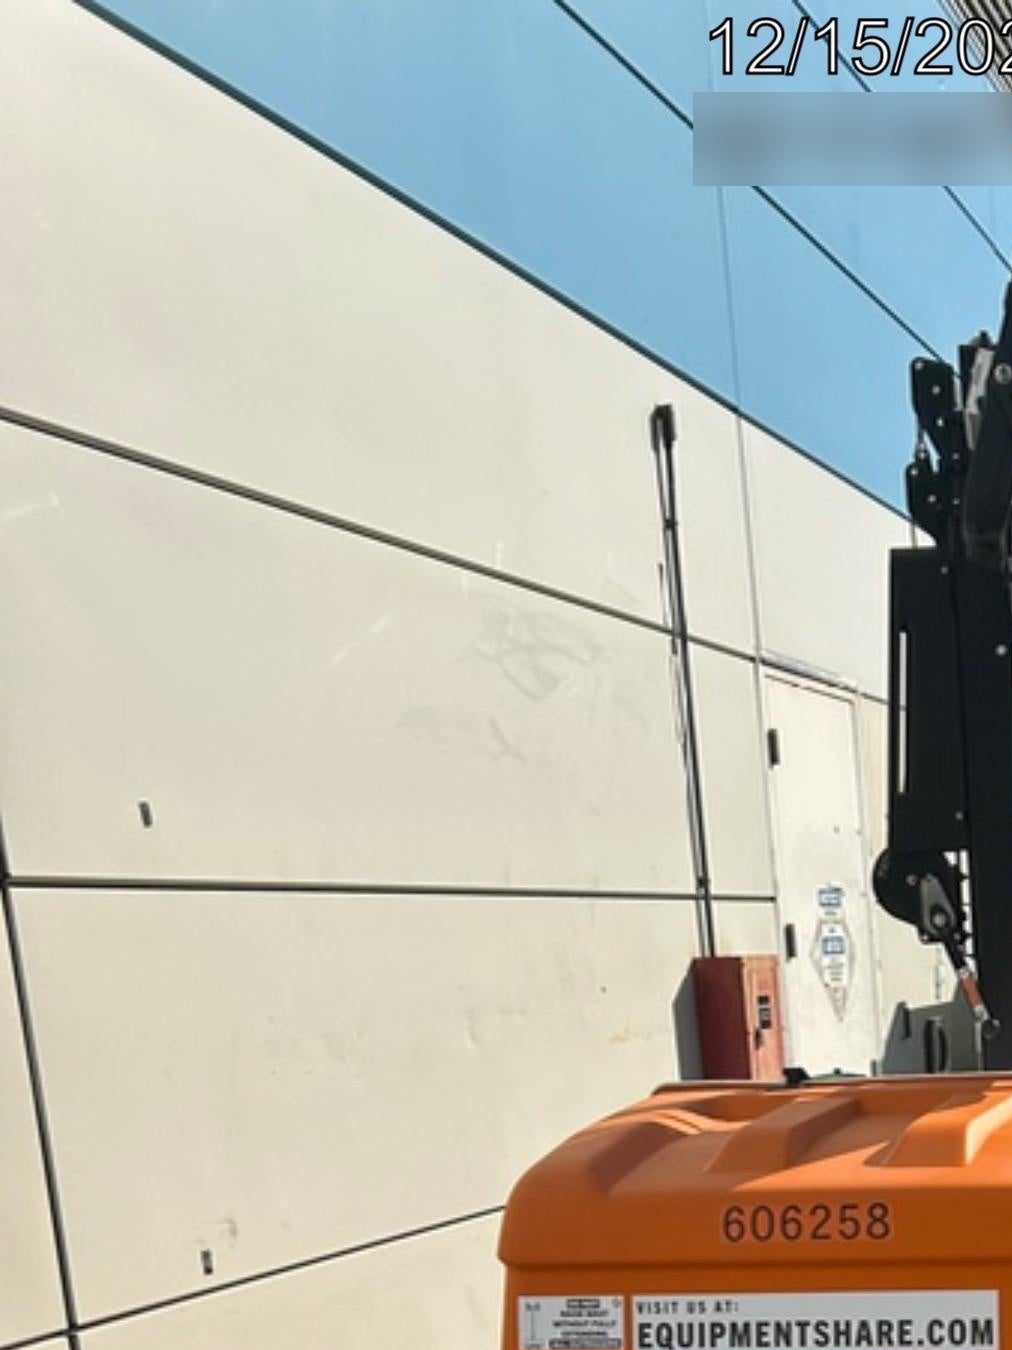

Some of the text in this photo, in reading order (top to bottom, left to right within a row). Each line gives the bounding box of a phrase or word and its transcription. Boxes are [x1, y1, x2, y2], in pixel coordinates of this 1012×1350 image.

[722, 1203, 892, 1243] 606258
[635, 1299, 740, 1314] VISIT US AT:
[637, 1318, 994, 1350] EQUIPMENTSHARE.COM
